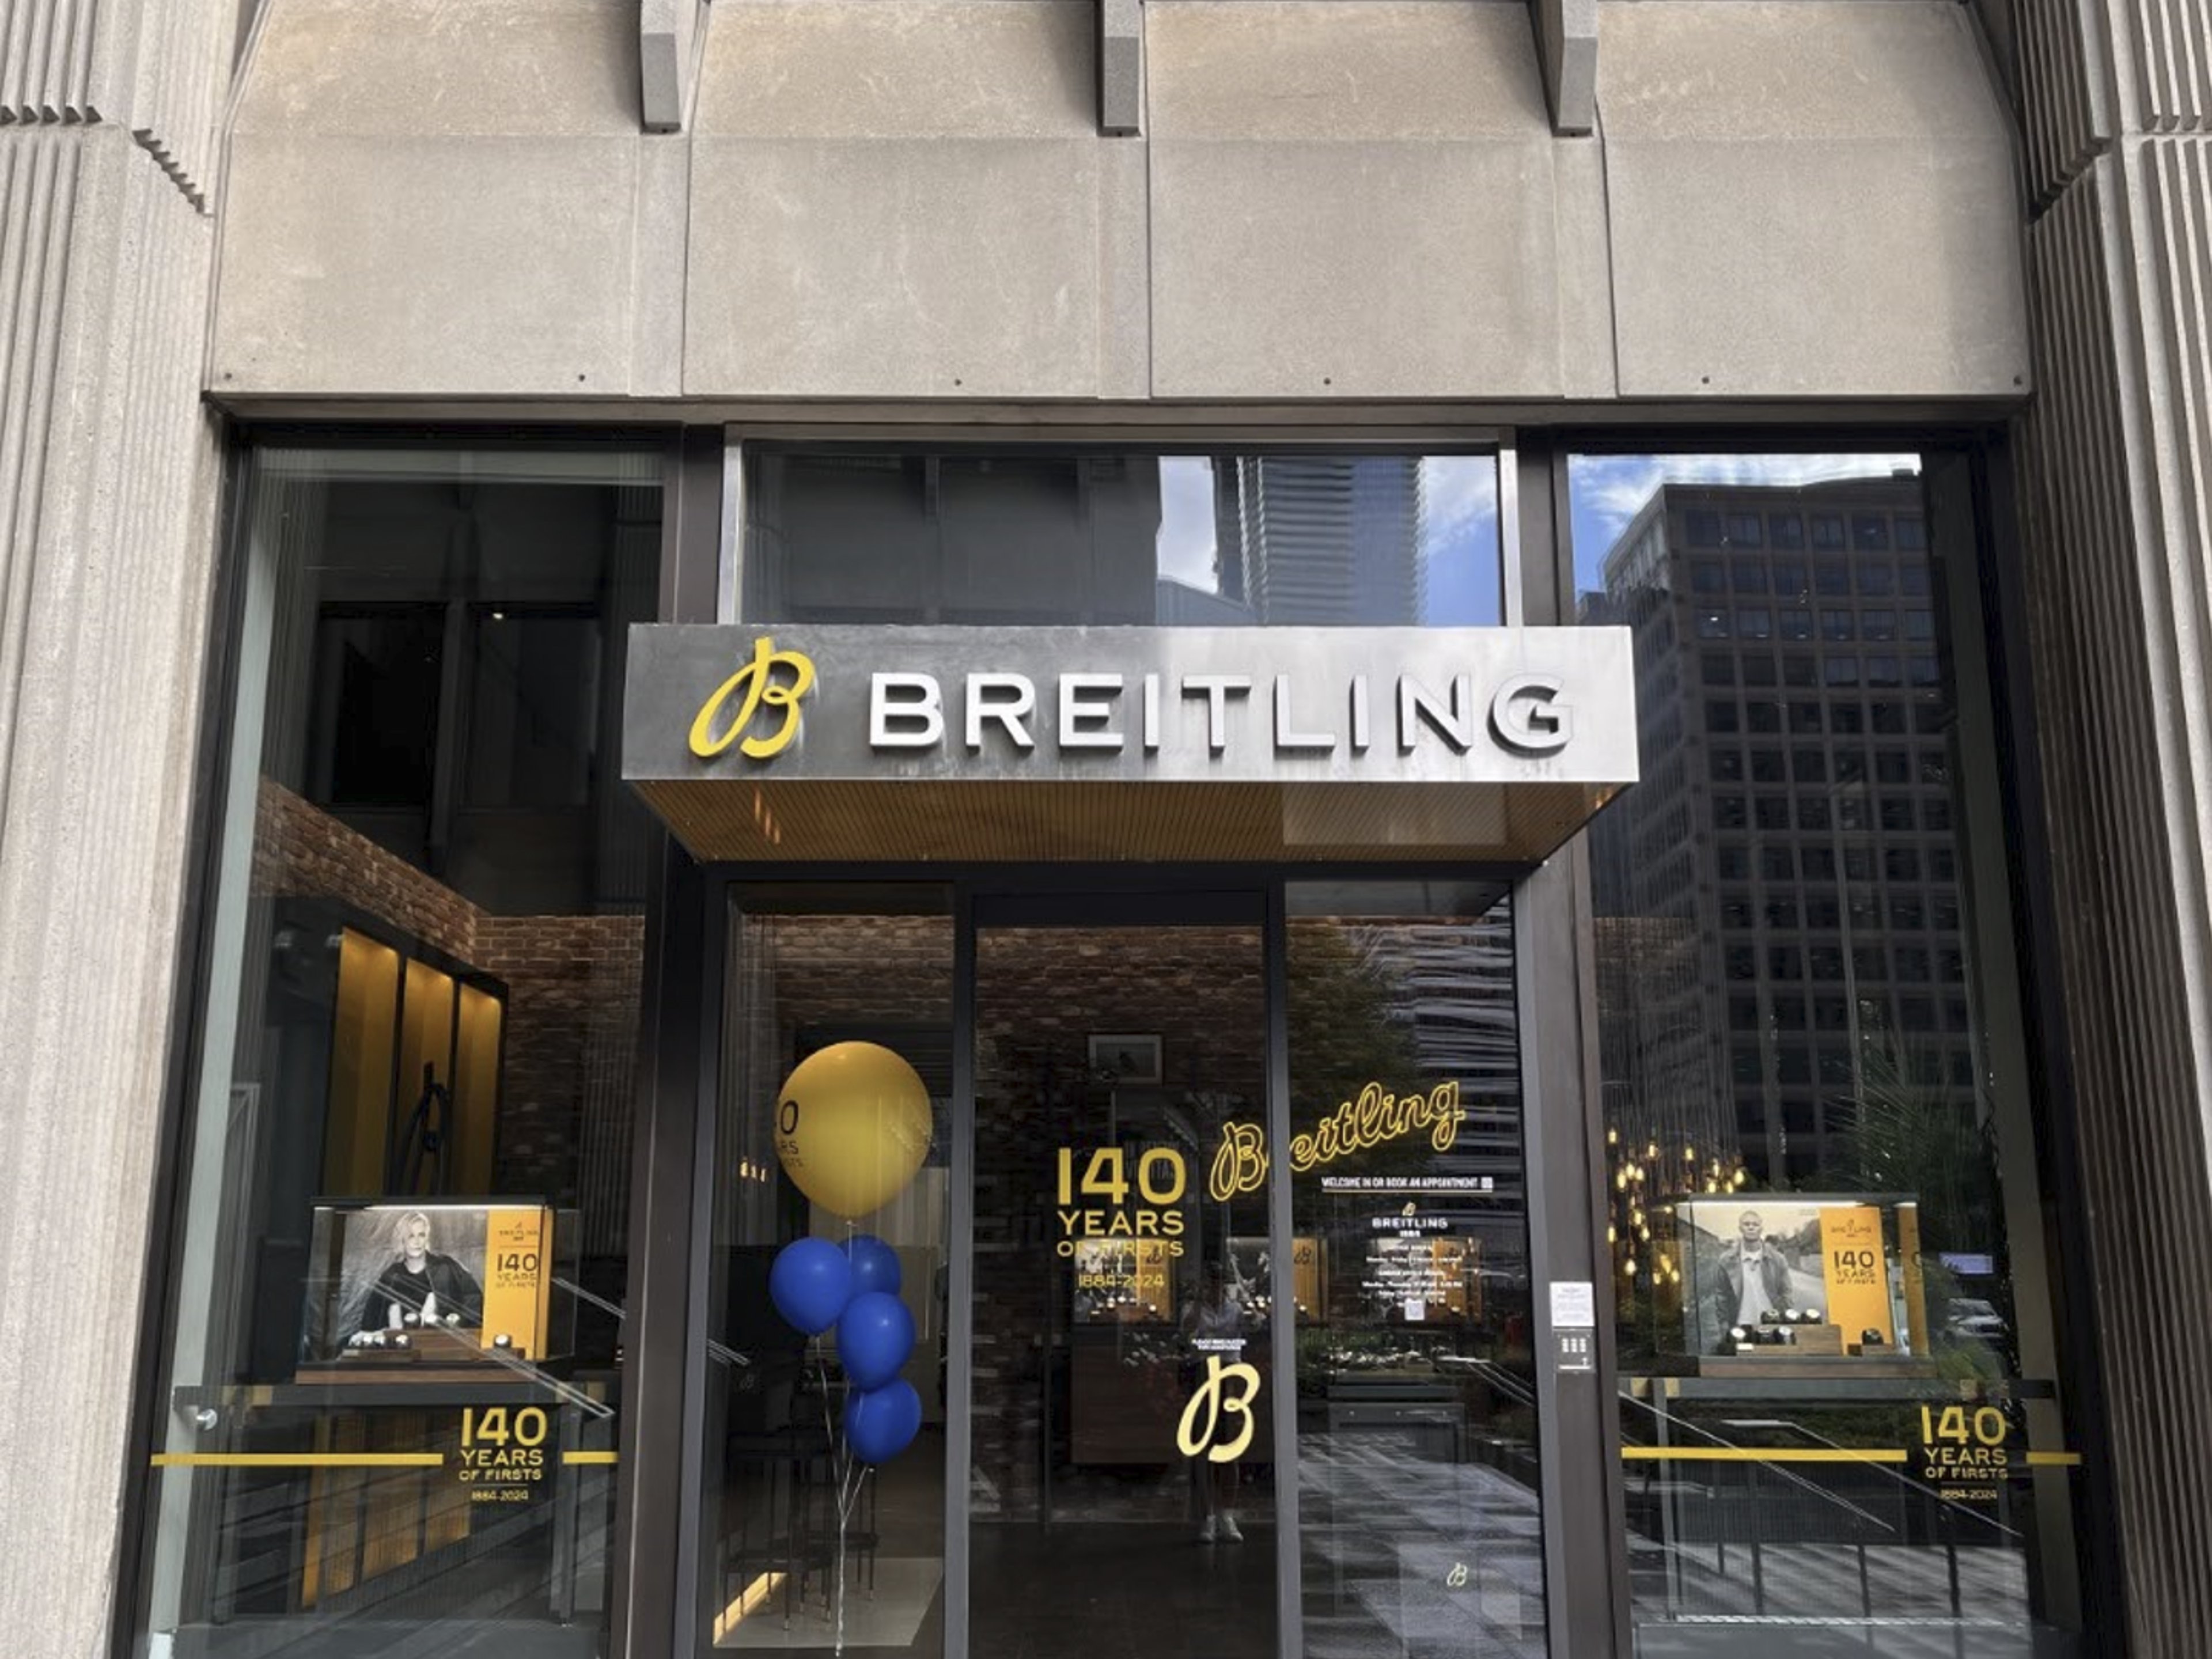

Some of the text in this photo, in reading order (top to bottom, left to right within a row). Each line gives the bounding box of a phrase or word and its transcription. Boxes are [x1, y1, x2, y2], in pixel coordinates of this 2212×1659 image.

[688, 637, 1574, 760] B BREITLING
[1209, 1081, 1467, 1202] Beitling
[1058, 1146, 1187, 1205] 140
[1321, 1177, 1360, 1188] WELCOME
[1362, 1177, 1371, 1187] IN
[1373, 1177, 1384, 1187] OR
[1387, 1177, 1407, 1188] BOOK
[1422, 1177, 1478, 1188] APPOINTMENT
[1057, 1210, 1185, 1236] YEARS
[1372, 1217, 1448, 1229] BREITLING
[497, 1253, 537, 1272] 140
[1834, 1251, 1874, 1268] 140
[1177, 1356, 1260, 1463] B
[461, 1407, 547, 1447] 140
[1921, 1406, 2006, 1446] 140
[460, 1449, 544, 1467] YEARS
[1924, 1447, 2008, 1465] YEARS
[459, 1468, 543, 1481] OF FIRSTS
[1925, 1467, 2009, 1479] OF FIRSTS
